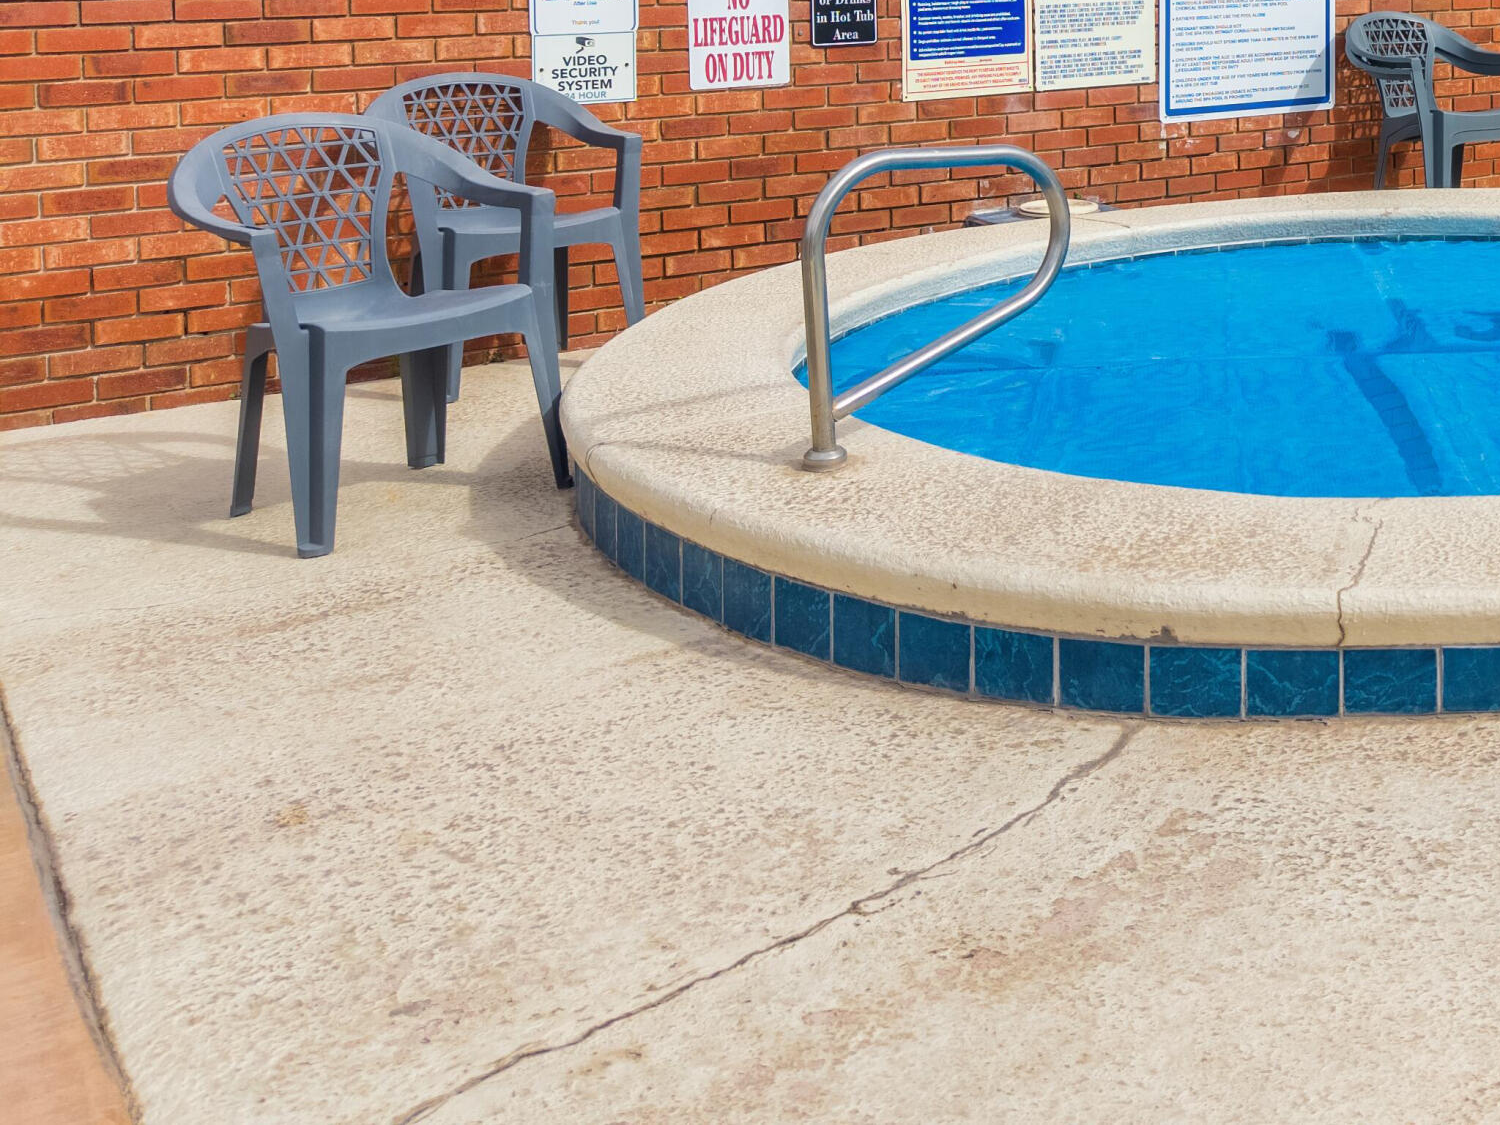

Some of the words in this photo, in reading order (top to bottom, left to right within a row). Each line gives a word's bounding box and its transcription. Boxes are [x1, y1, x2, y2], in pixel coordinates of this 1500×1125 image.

[817, 12, 827, 23] in
[830, 11, 851, 22] Hot
[854, 9, 873, 21] Tub
[693, 14, 784, 47] LIFEGUARD
[833, 28, 858, 40] Area
[563, 55, 607, 66] VIDEO
[552, 66, 618, 79] SECURITY
[705, 53, 727, 83] ON
[733, 51, 774, 81] DUTY
[558, 79, 612, 91] SYSTEM
[579, 91, 606, 99] HOUR
